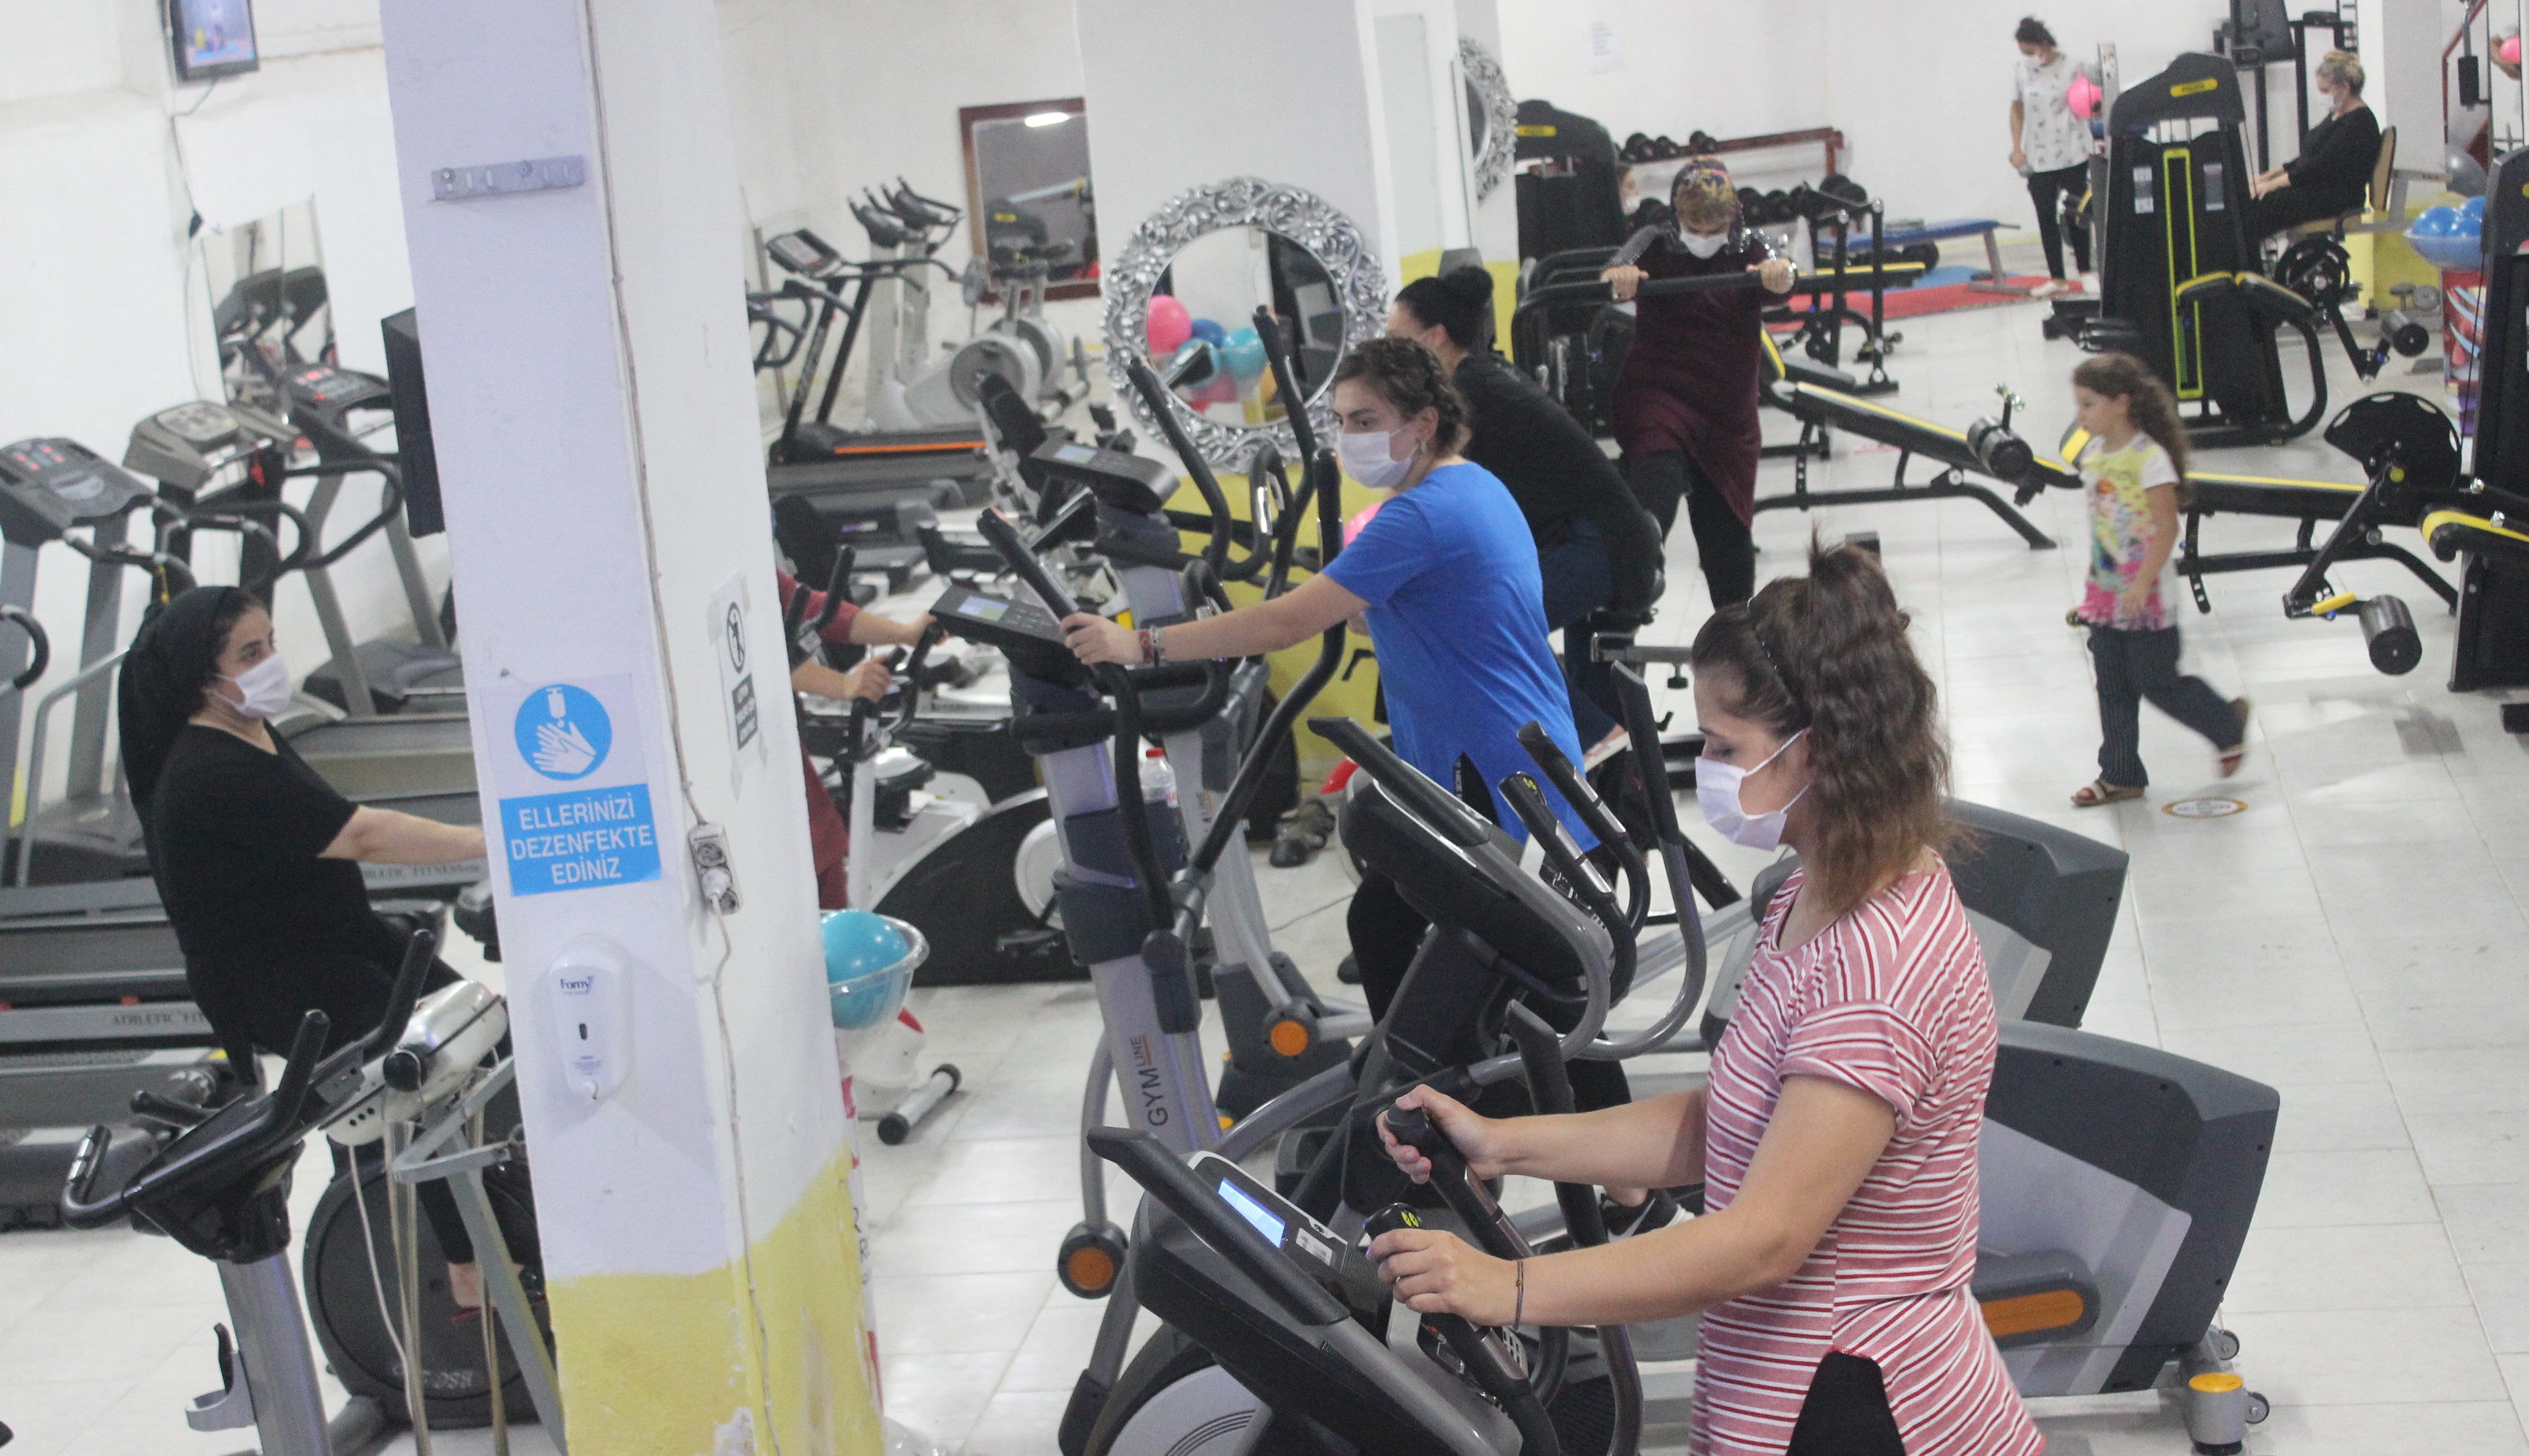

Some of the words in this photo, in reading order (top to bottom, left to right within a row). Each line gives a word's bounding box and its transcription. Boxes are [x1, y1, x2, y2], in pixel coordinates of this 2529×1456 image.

[519, 792, 634, 830] ELLERİNİZİ
[512, 825, 652, 860] DEZENFEKTE
[551, 854, 621, 885] EDİNİZ
[1131, 1036, 1147, 1067] LINE
[1138, 1067, 1169, 1126] GYM
